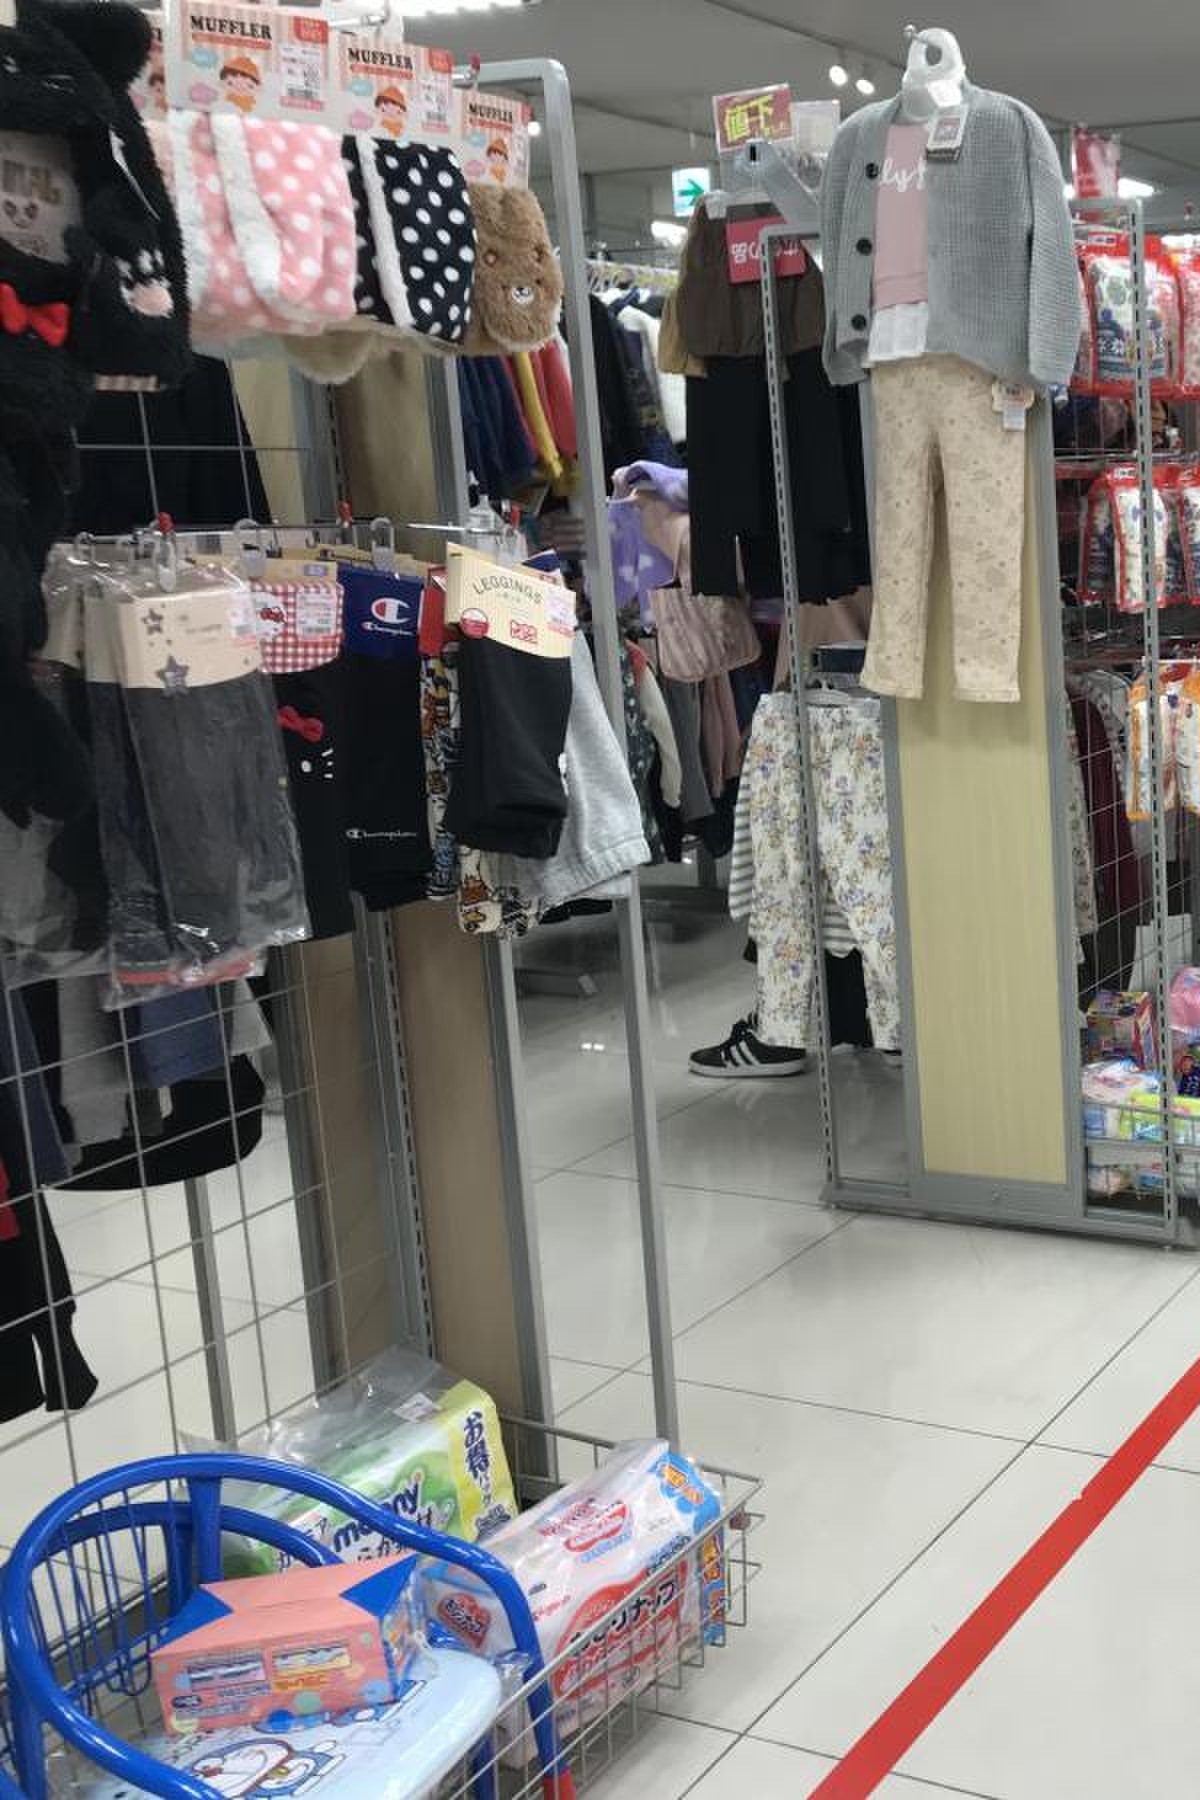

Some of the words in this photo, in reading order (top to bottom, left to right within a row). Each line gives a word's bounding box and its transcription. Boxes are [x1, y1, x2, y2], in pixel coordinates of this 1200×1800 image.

[190, 15, 272, 40] MUFFLER
[347, 47, 413, 70] MUFFLER
[468, 102, 513, 122] MUFFLER
[472, 575, 542, 604] LEGGINGS
